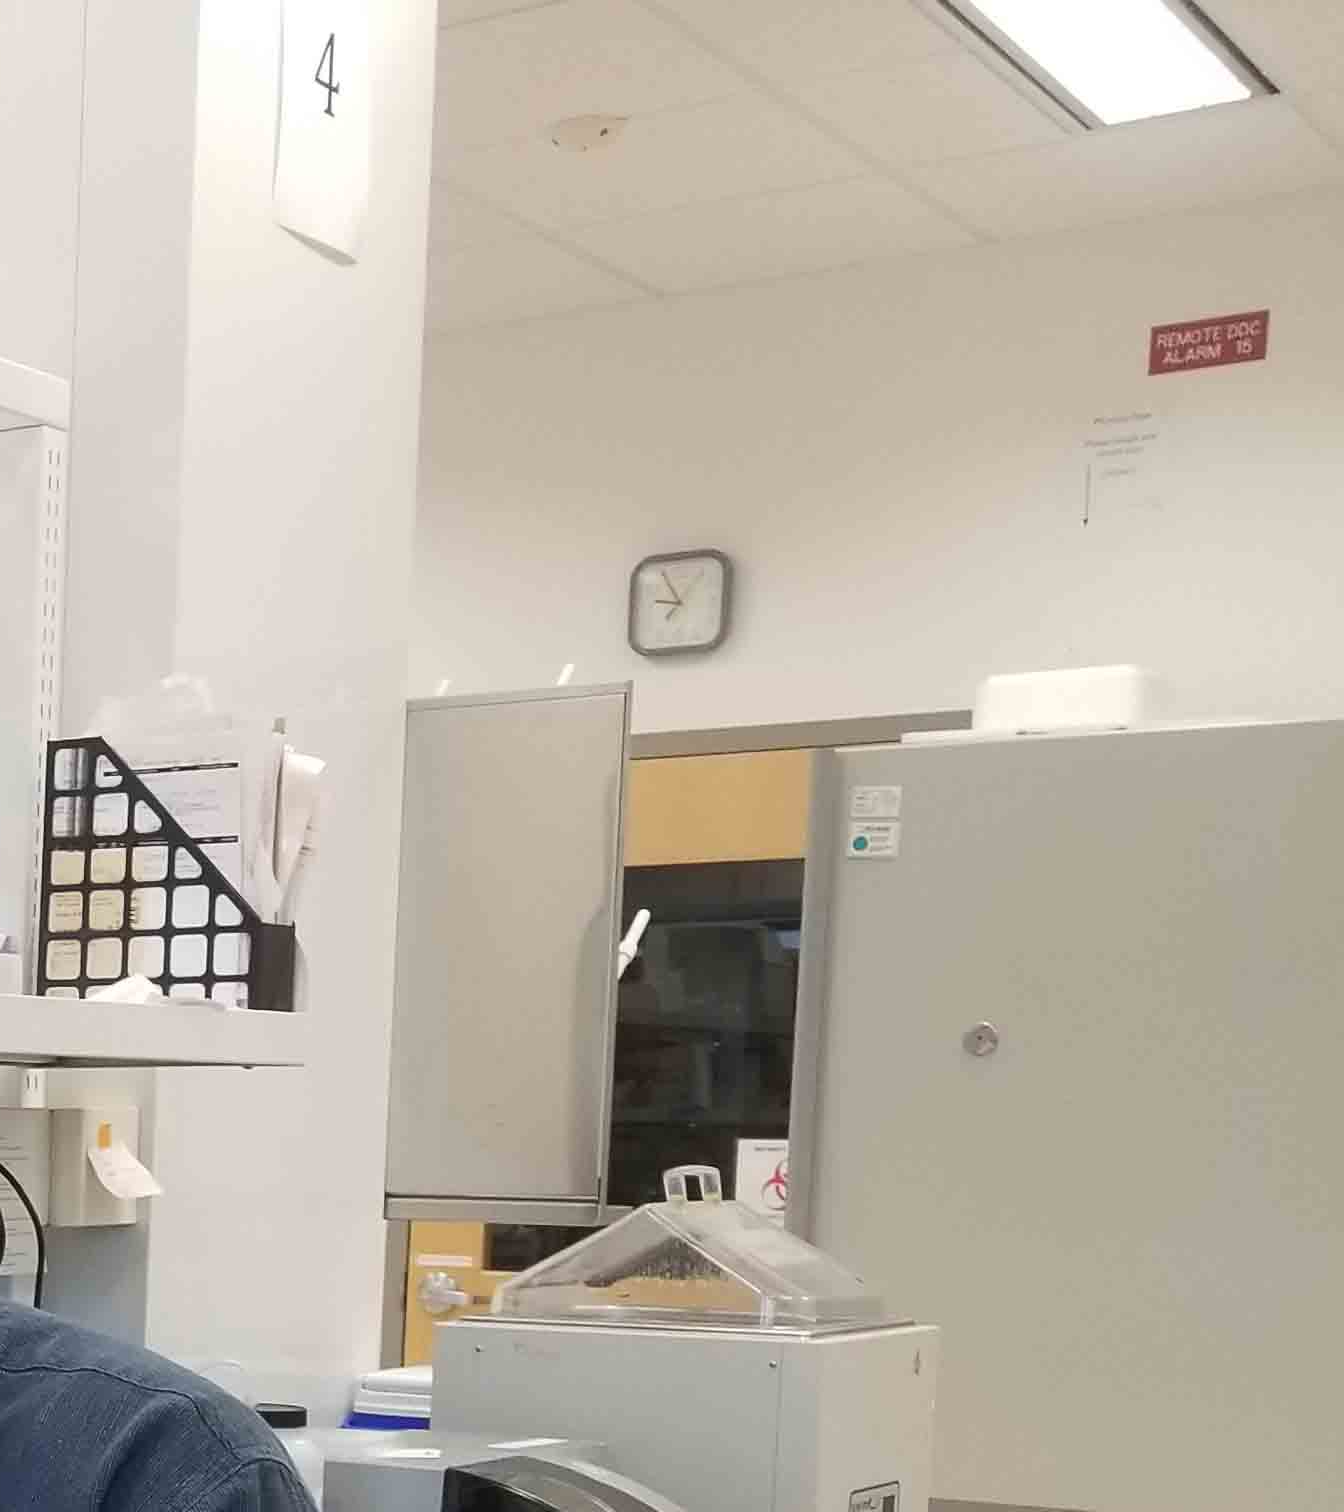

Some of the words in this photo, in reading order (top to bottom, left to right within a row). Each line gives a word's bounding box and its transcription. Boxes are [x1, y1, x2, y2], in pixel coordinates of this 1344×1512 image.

[315, 32, 340, 118] 4
[1157, 325, 1224, 348] REMOTE
[1162, 343, 1222, 364] ALARM
